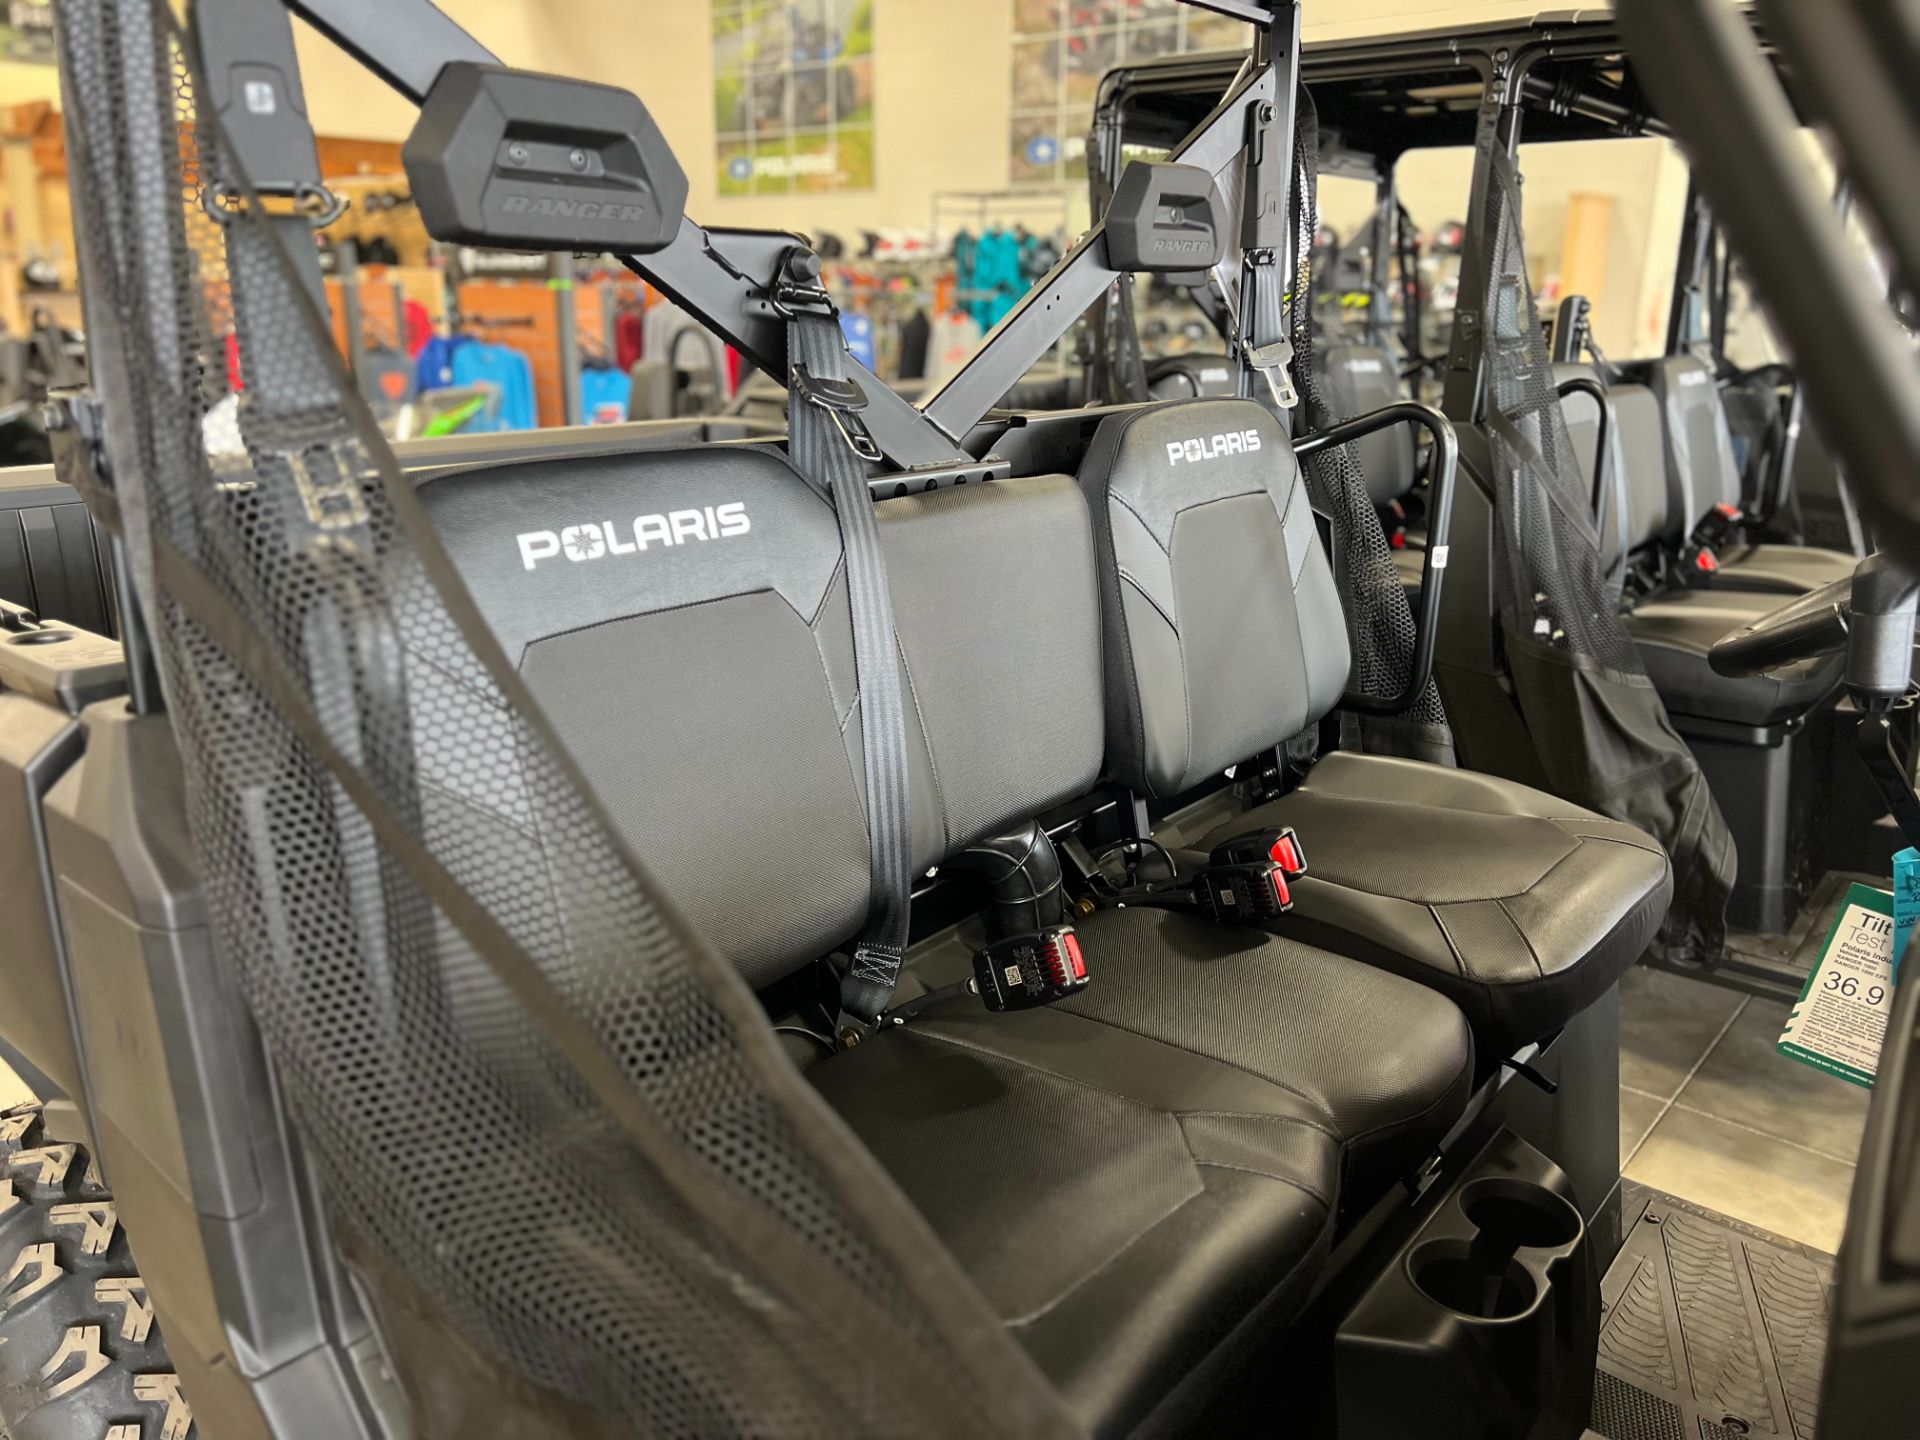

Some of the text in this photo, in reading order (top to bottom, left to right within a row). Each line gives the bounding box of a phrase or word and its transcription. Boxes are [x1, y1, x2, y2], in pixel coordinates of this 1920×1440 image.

[501, 195, 645, 222] RANGER
[1153, 239, 1210, 253] RANGER
[1166, 428, 1262, 467] POLARIS
[516, 501, 751, 571] POLARIS
[1862, 912, 1893, 936] Tilt
[1850, 925, 1889, 951] Test
[1834, 959, 1859, 971] RANGER
[1836, 954, 1861, 967] RANGER
[1841, 942, 1894, 965] Polaris Indu
[1824, 971, 1884, 1006] 36.9
